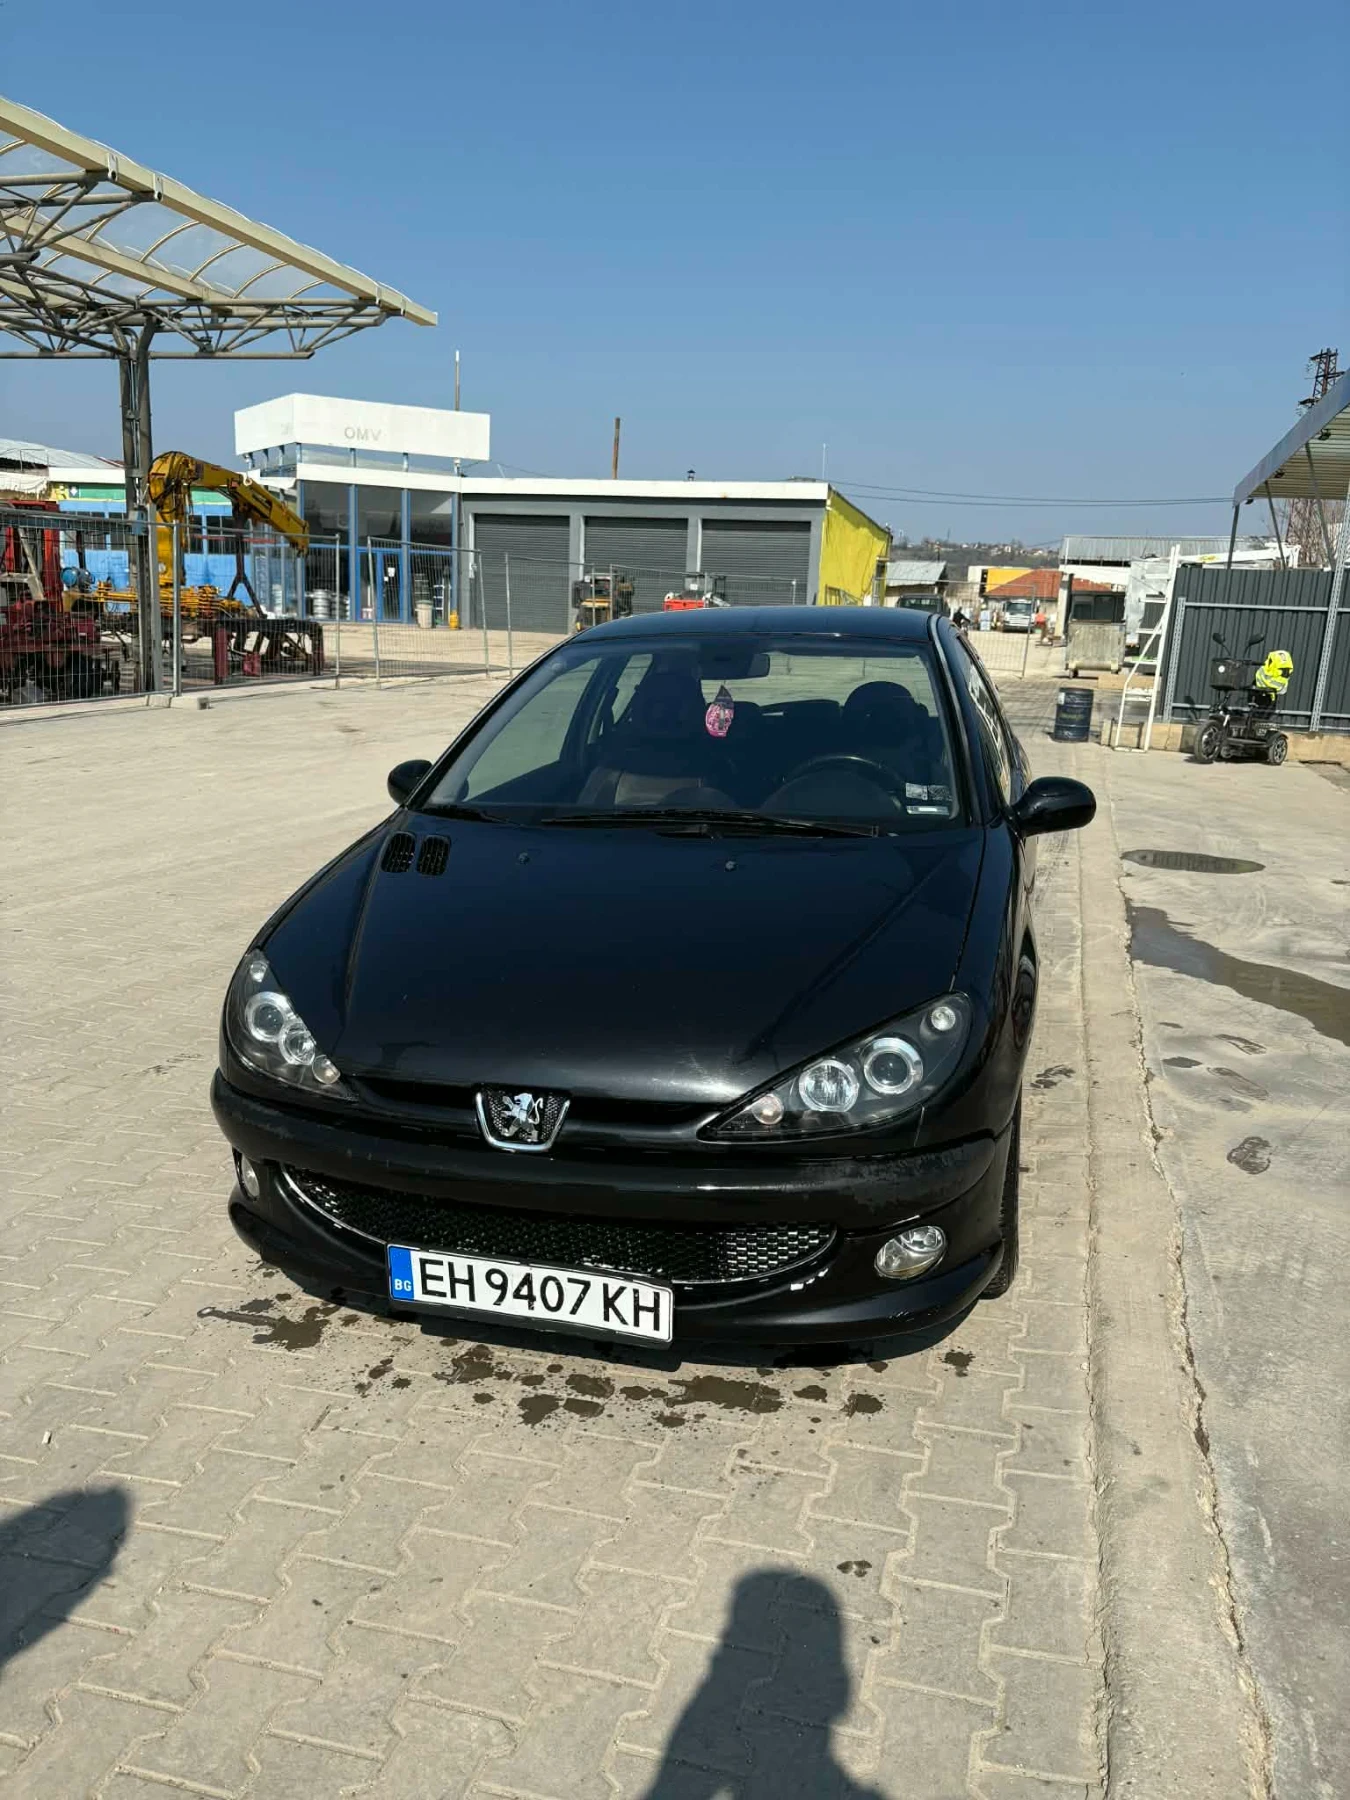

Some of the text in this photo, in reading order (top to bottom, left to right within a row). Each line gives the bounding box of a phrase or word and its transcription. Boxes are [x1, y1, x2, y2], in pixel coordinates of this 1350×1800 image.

[344, 427, 381, 441] OMV
[394, 1279, 412, 1291] BG
[419, 1258, 660, 1331] EH 9407 KH
